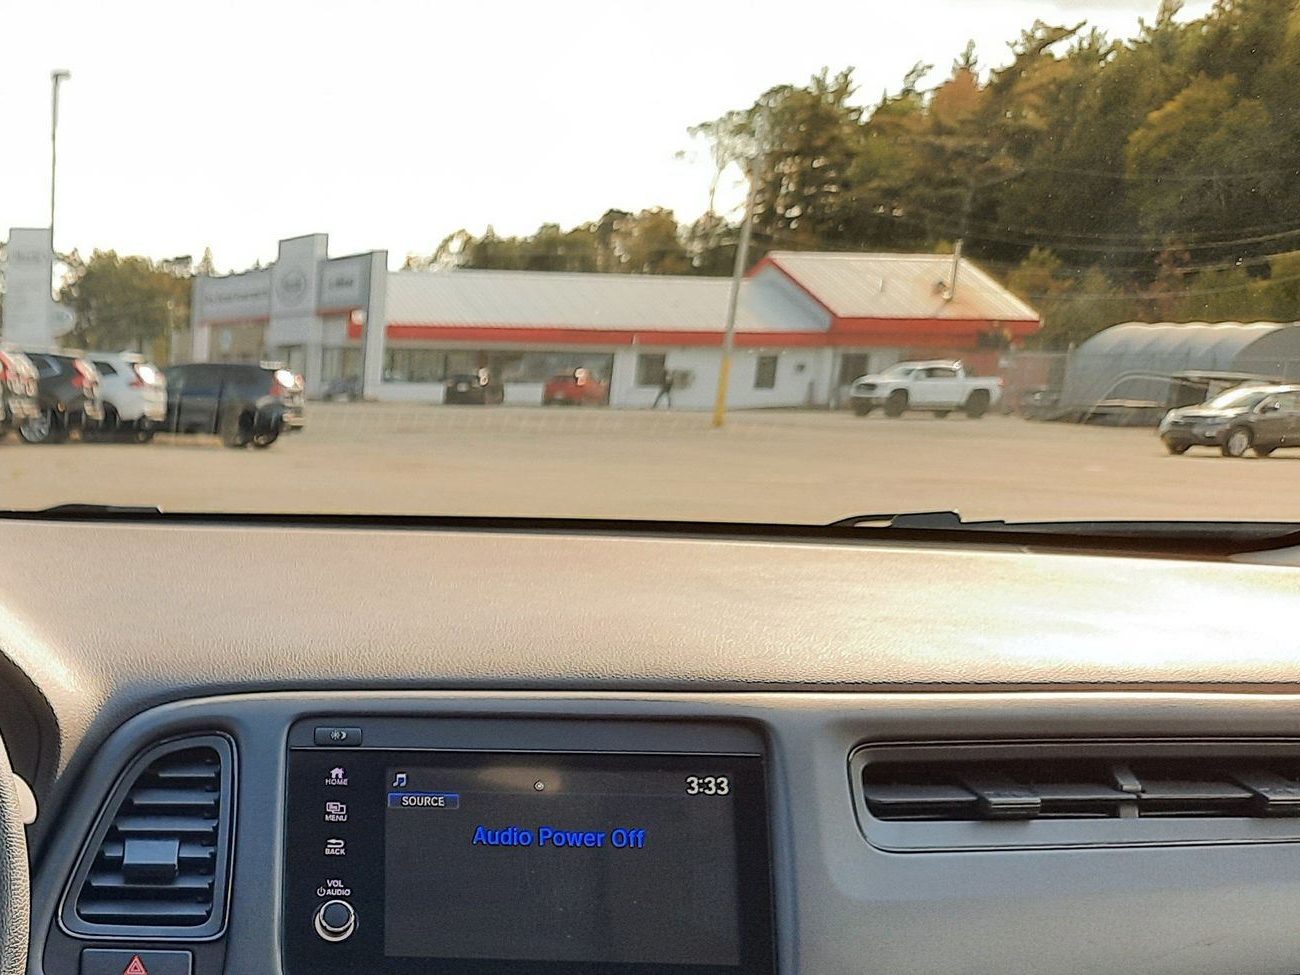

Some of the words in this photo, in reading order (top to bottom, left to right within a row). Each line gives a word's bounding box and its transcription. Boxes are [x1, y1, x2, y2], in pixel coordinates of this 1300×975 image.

[686, 776, 729, 795] 3:33
[402, 796, 445, 807] SOURCE
[472, 825, 533, 846] Audio
[539, 826, 605, 847] Power
[611, 828, 646, 848] Off
